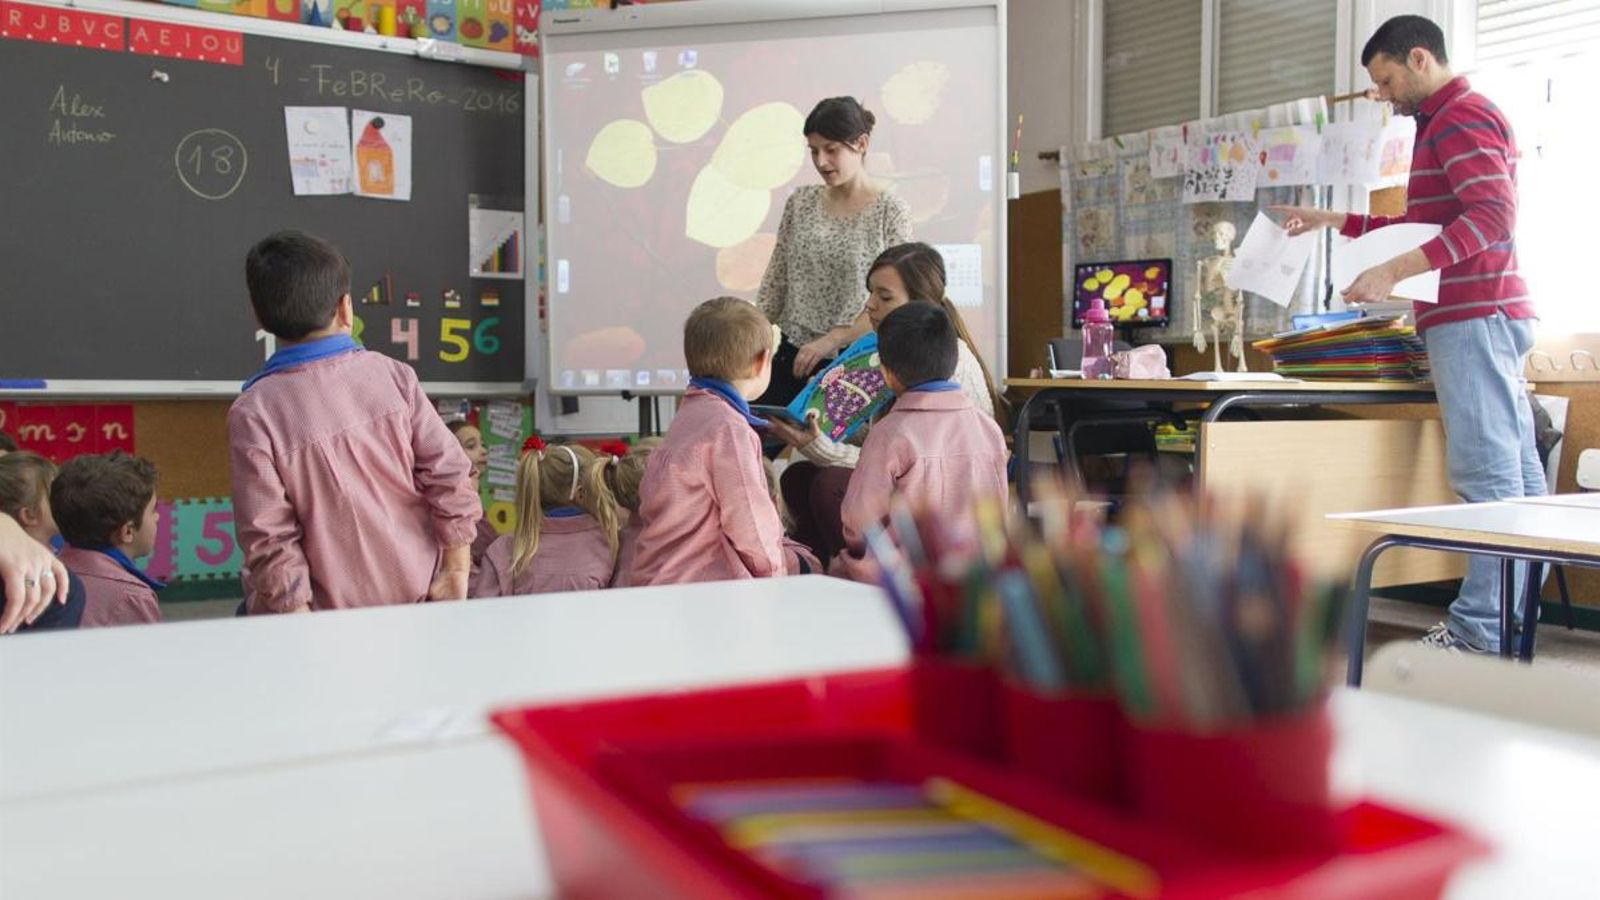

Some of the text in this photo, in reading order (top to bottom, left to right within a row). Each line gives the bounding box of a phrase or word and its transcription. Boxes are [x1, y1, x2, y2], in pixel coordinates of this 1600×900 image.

[264, 56, 280, 85] 4
[50, 84, 105, 117] Alex
[188, 145, 235, 174] 18
[391, 318, 419, 361] 4
[439, 318, 471, 363] 5
[473, 317, 499, 356] 6
[102, 422, 128, 440] n
[195, 511, 234, 567] 5
